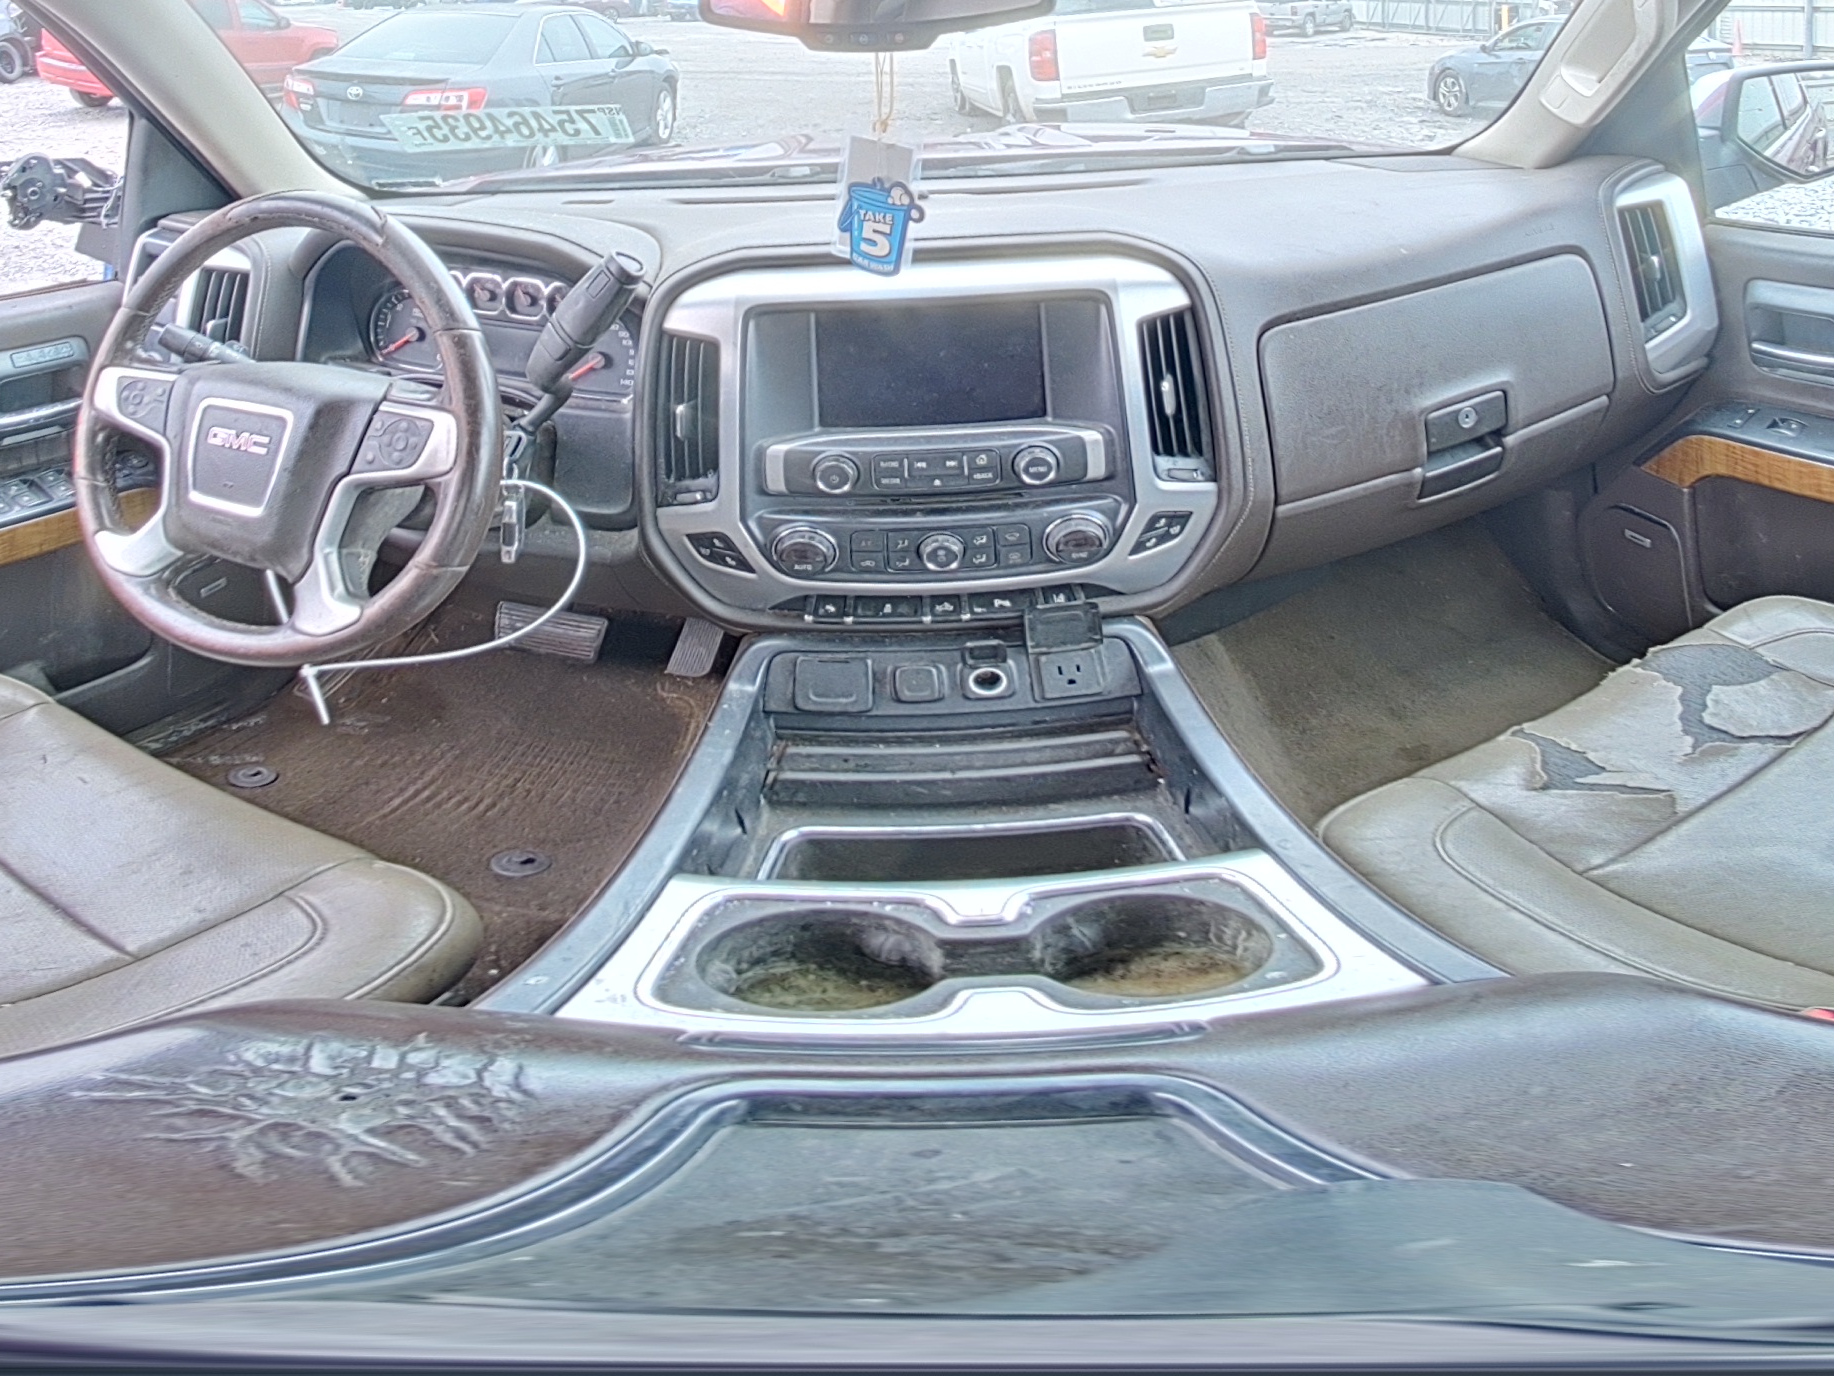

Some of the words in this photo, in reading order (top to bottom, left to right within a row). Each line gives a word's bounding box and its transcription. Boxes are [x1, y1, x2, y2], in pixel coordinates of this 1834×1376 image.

[858, 209, 893, 224] TAKE
[859, 221, 892, 258] 5
[207, 426, 271, 455] GMC
[793, 563, 813, 571] AUTO
